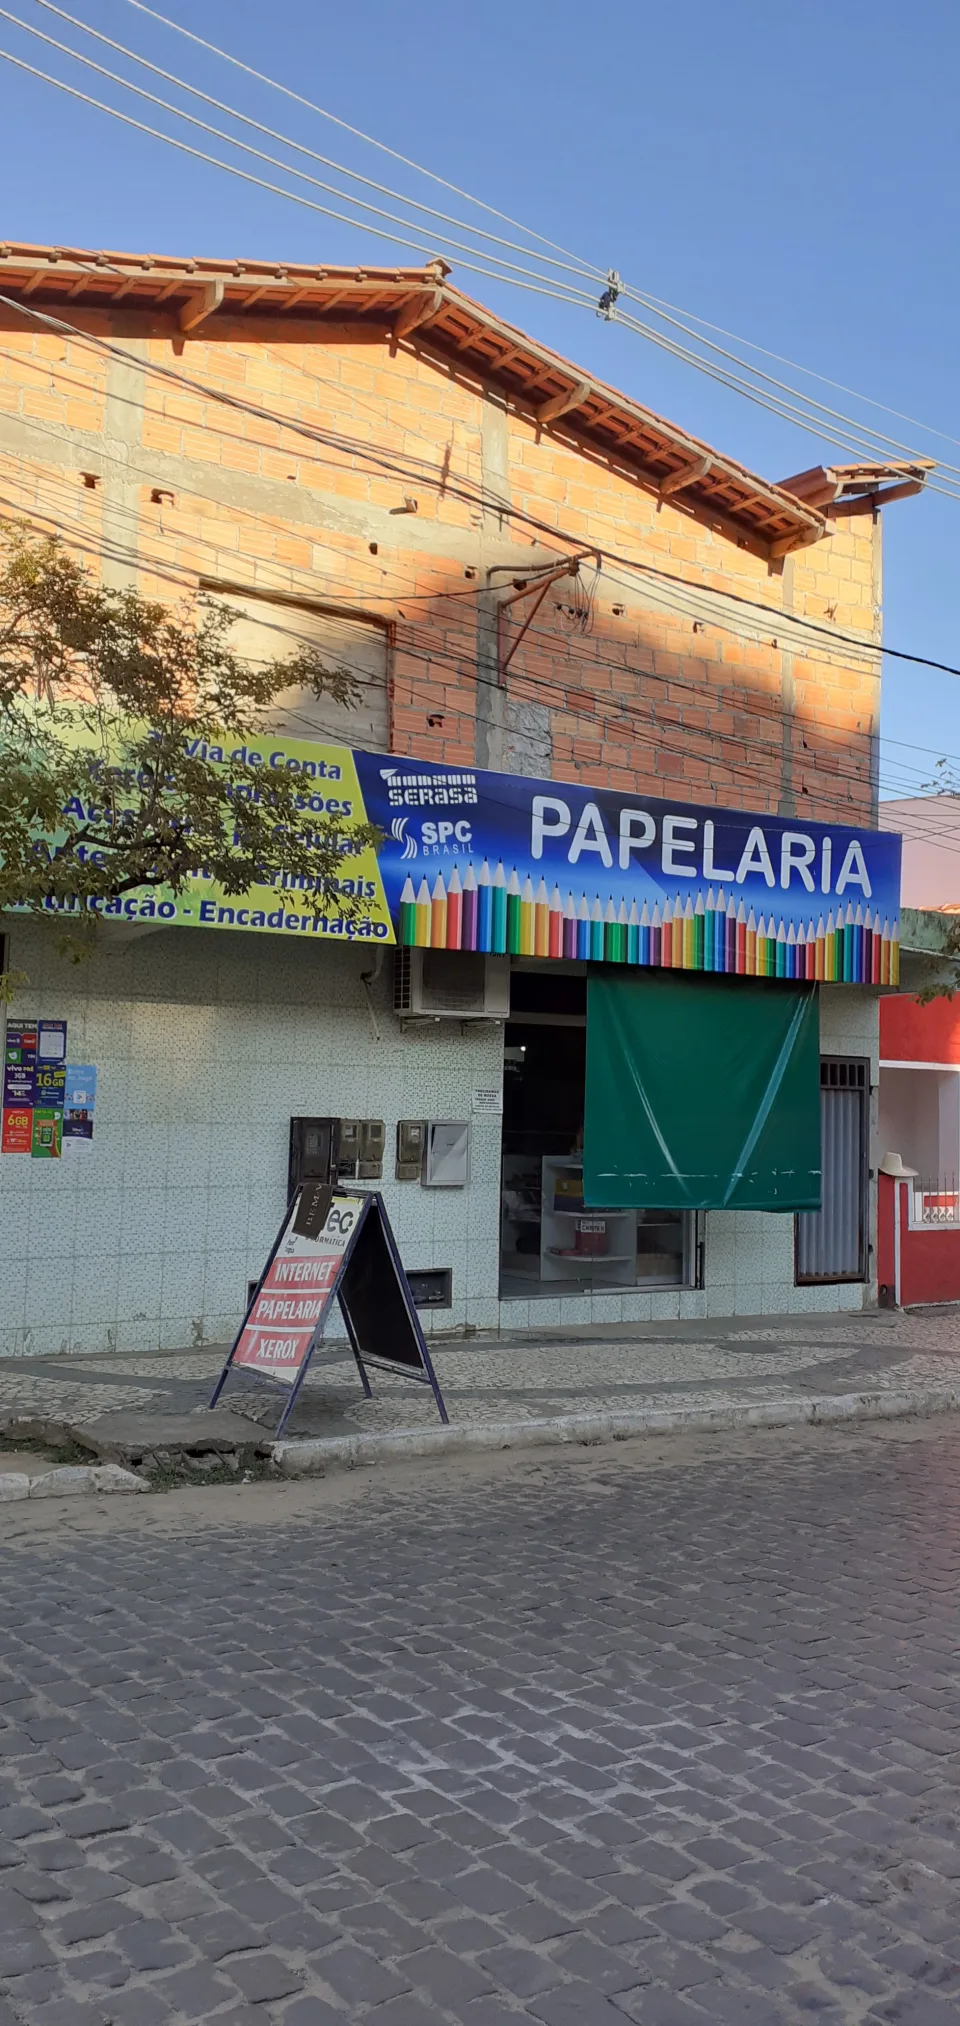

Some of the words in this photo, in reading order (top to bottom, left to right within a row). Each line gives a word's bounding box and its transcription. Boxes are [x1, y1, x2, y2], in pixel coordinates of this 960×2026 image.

[183, 738, 224, 763] Via
[231, 745, 263, 768] de
[269, 751, 342, 781] Conta
[421, 820, 473, 845] SPC
[422, 842, 475, 857] BRASIL
[531, 794, 874, 898] PAPELARIA
[199, 899, 390, 941] Encadernação
[36, 1072, 52, 1087] 16
[52, 1079, 64, 1087] GB
[8, 1115, 15, 1126] 6
[15, 1116, 28, 1126] GB
[274, 1261, 335, 1281] INTERNET
[255, 1299, 322, 1320] PAPELARIA
[256, 1337, 299, 1359] XEROX
